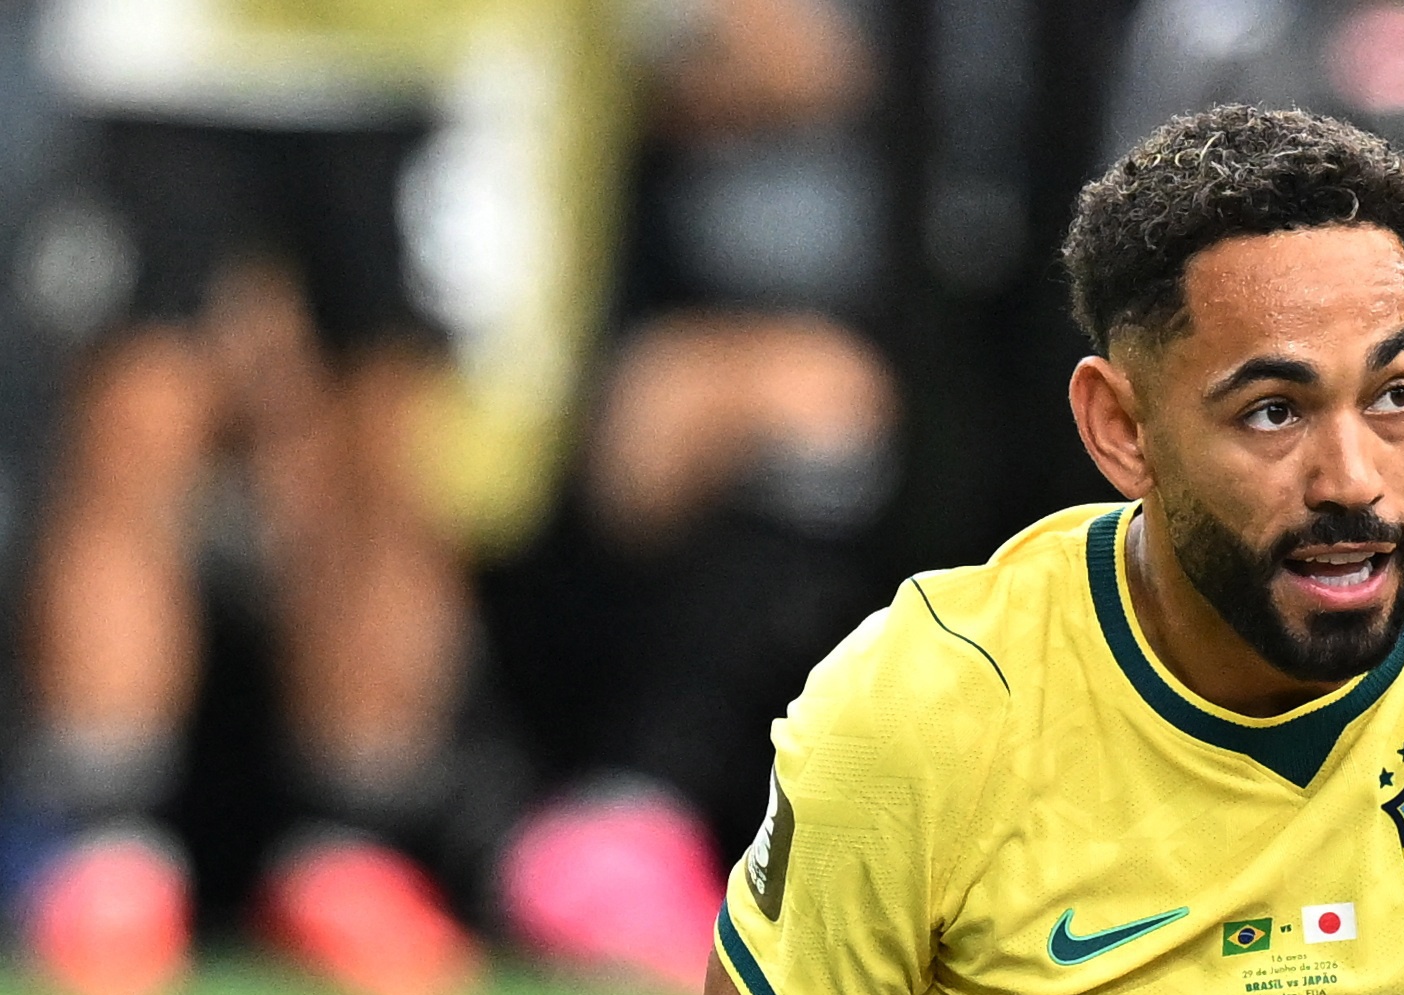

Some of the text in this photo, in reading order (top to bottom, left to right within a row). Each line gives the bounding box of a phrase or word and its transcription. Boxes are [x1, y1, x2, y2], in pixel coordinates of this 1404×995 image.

[1280, 924, 1292, 933] vs
[1271, 955, 1283, 963] 16
[1242, 970, 1253, 979] 29
[1256, 968, 1267, 976] de
[1300, 963, 1311, 971] de
[1314, 961, 1338, 970] 2026
[1302, 972, 1337, 986] JAPÃO
